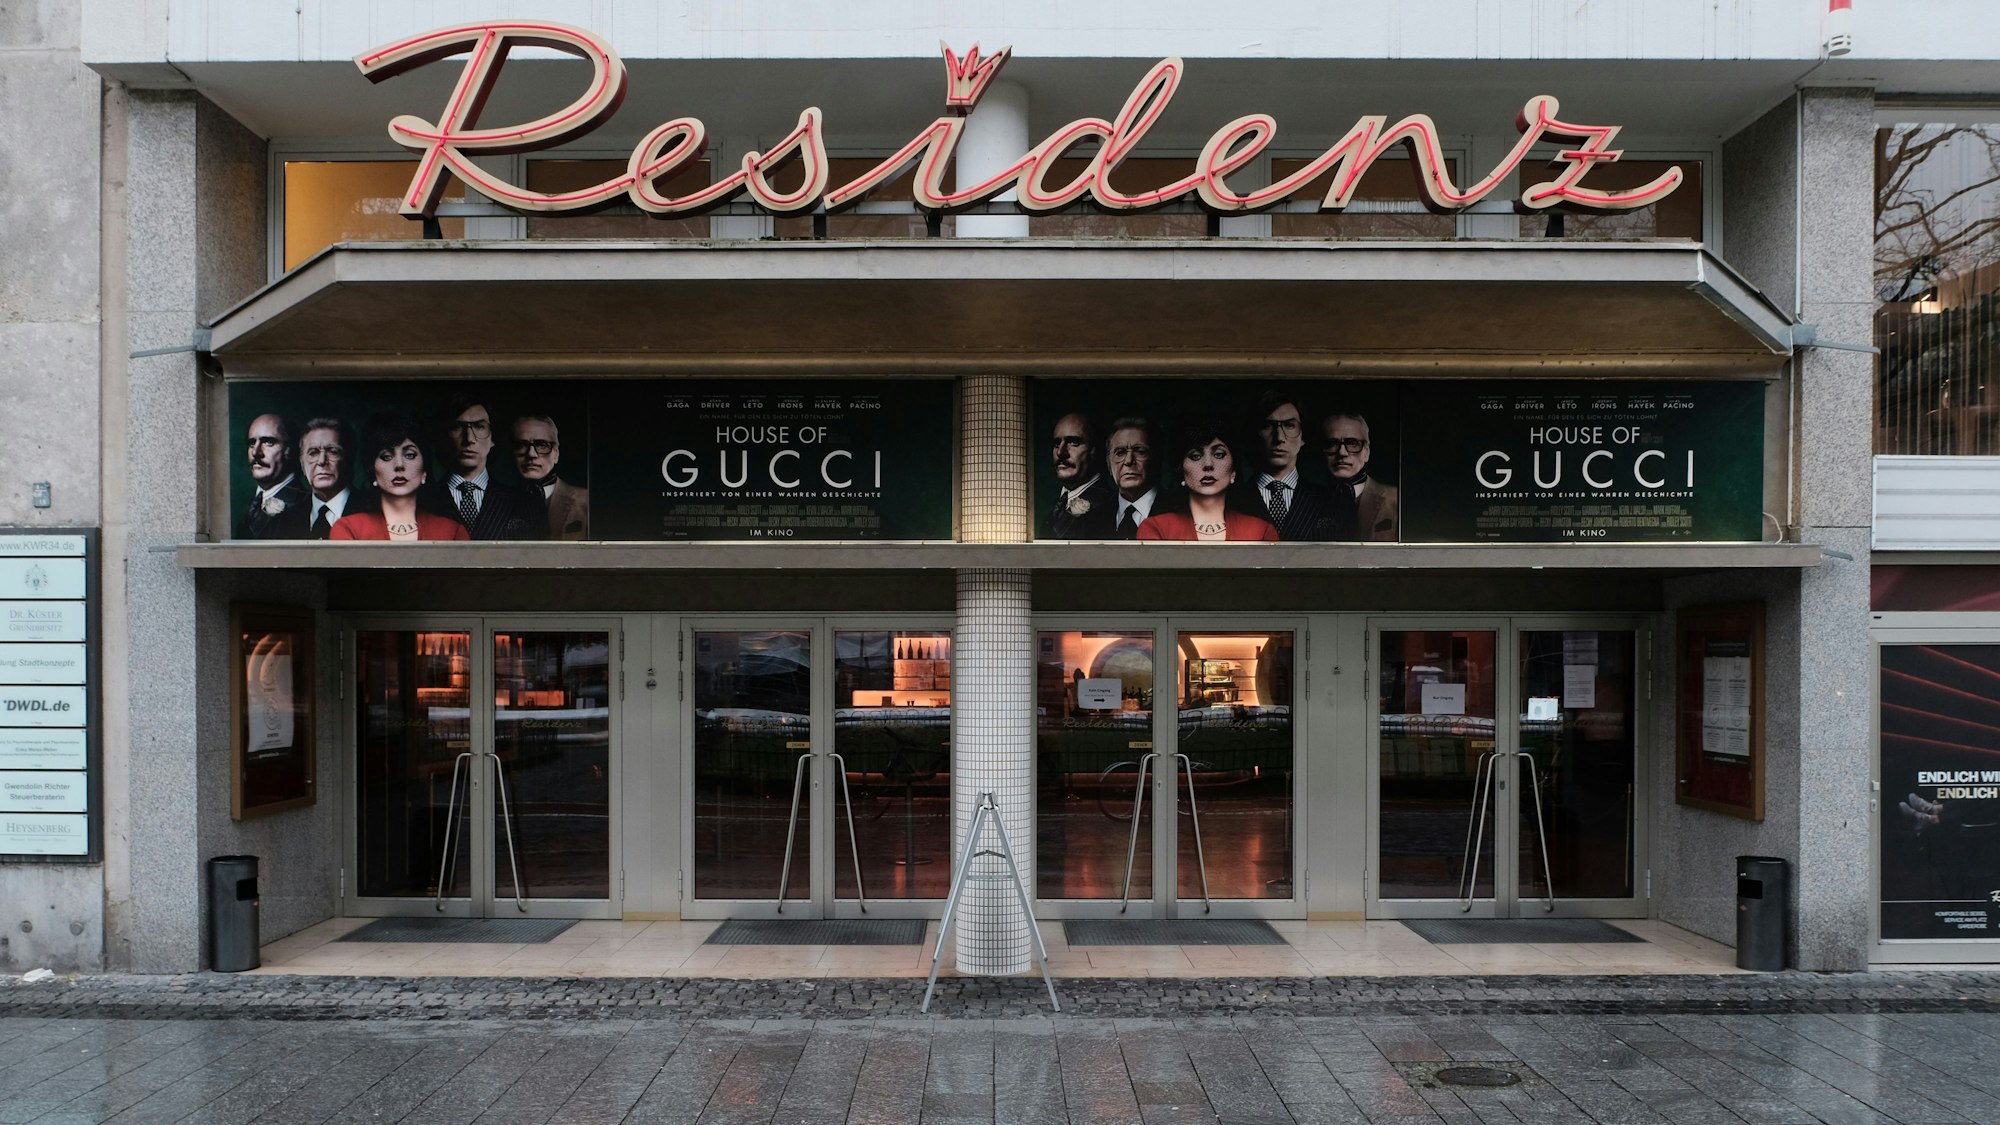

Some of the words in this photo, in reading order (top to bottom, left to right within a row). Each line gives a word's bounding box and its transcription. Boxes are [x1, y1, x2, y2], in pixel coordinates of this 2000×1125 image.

[353, 19, 1683, 219] Residenz
[1480, 402, 1504, 410] GAGA
[1515, 402, 1545, 410] DRIVER
[1557, 402, 1577, 410] LETO
[716, 426, 789, 444] HOUSE
[798, 426, 828, 444] OF
[1530, 426, 1603, 444] HOUSE
[1612, 426, 1641, 444] OF
[661, 449, 881, 488] GUCCI
[1475, 449, 1694, 489] GUCCI
[767, 529, 794, 537] KINO
[1562, 529, 1575, 537] IM
[1580, 529, 1607, 537] KINO
[19, 659, 75, 668] Stadtkonzepte
[1918, 771, 1979, 783] ENDLICH
[1937, 787, 1998, 799] ENDLICH
